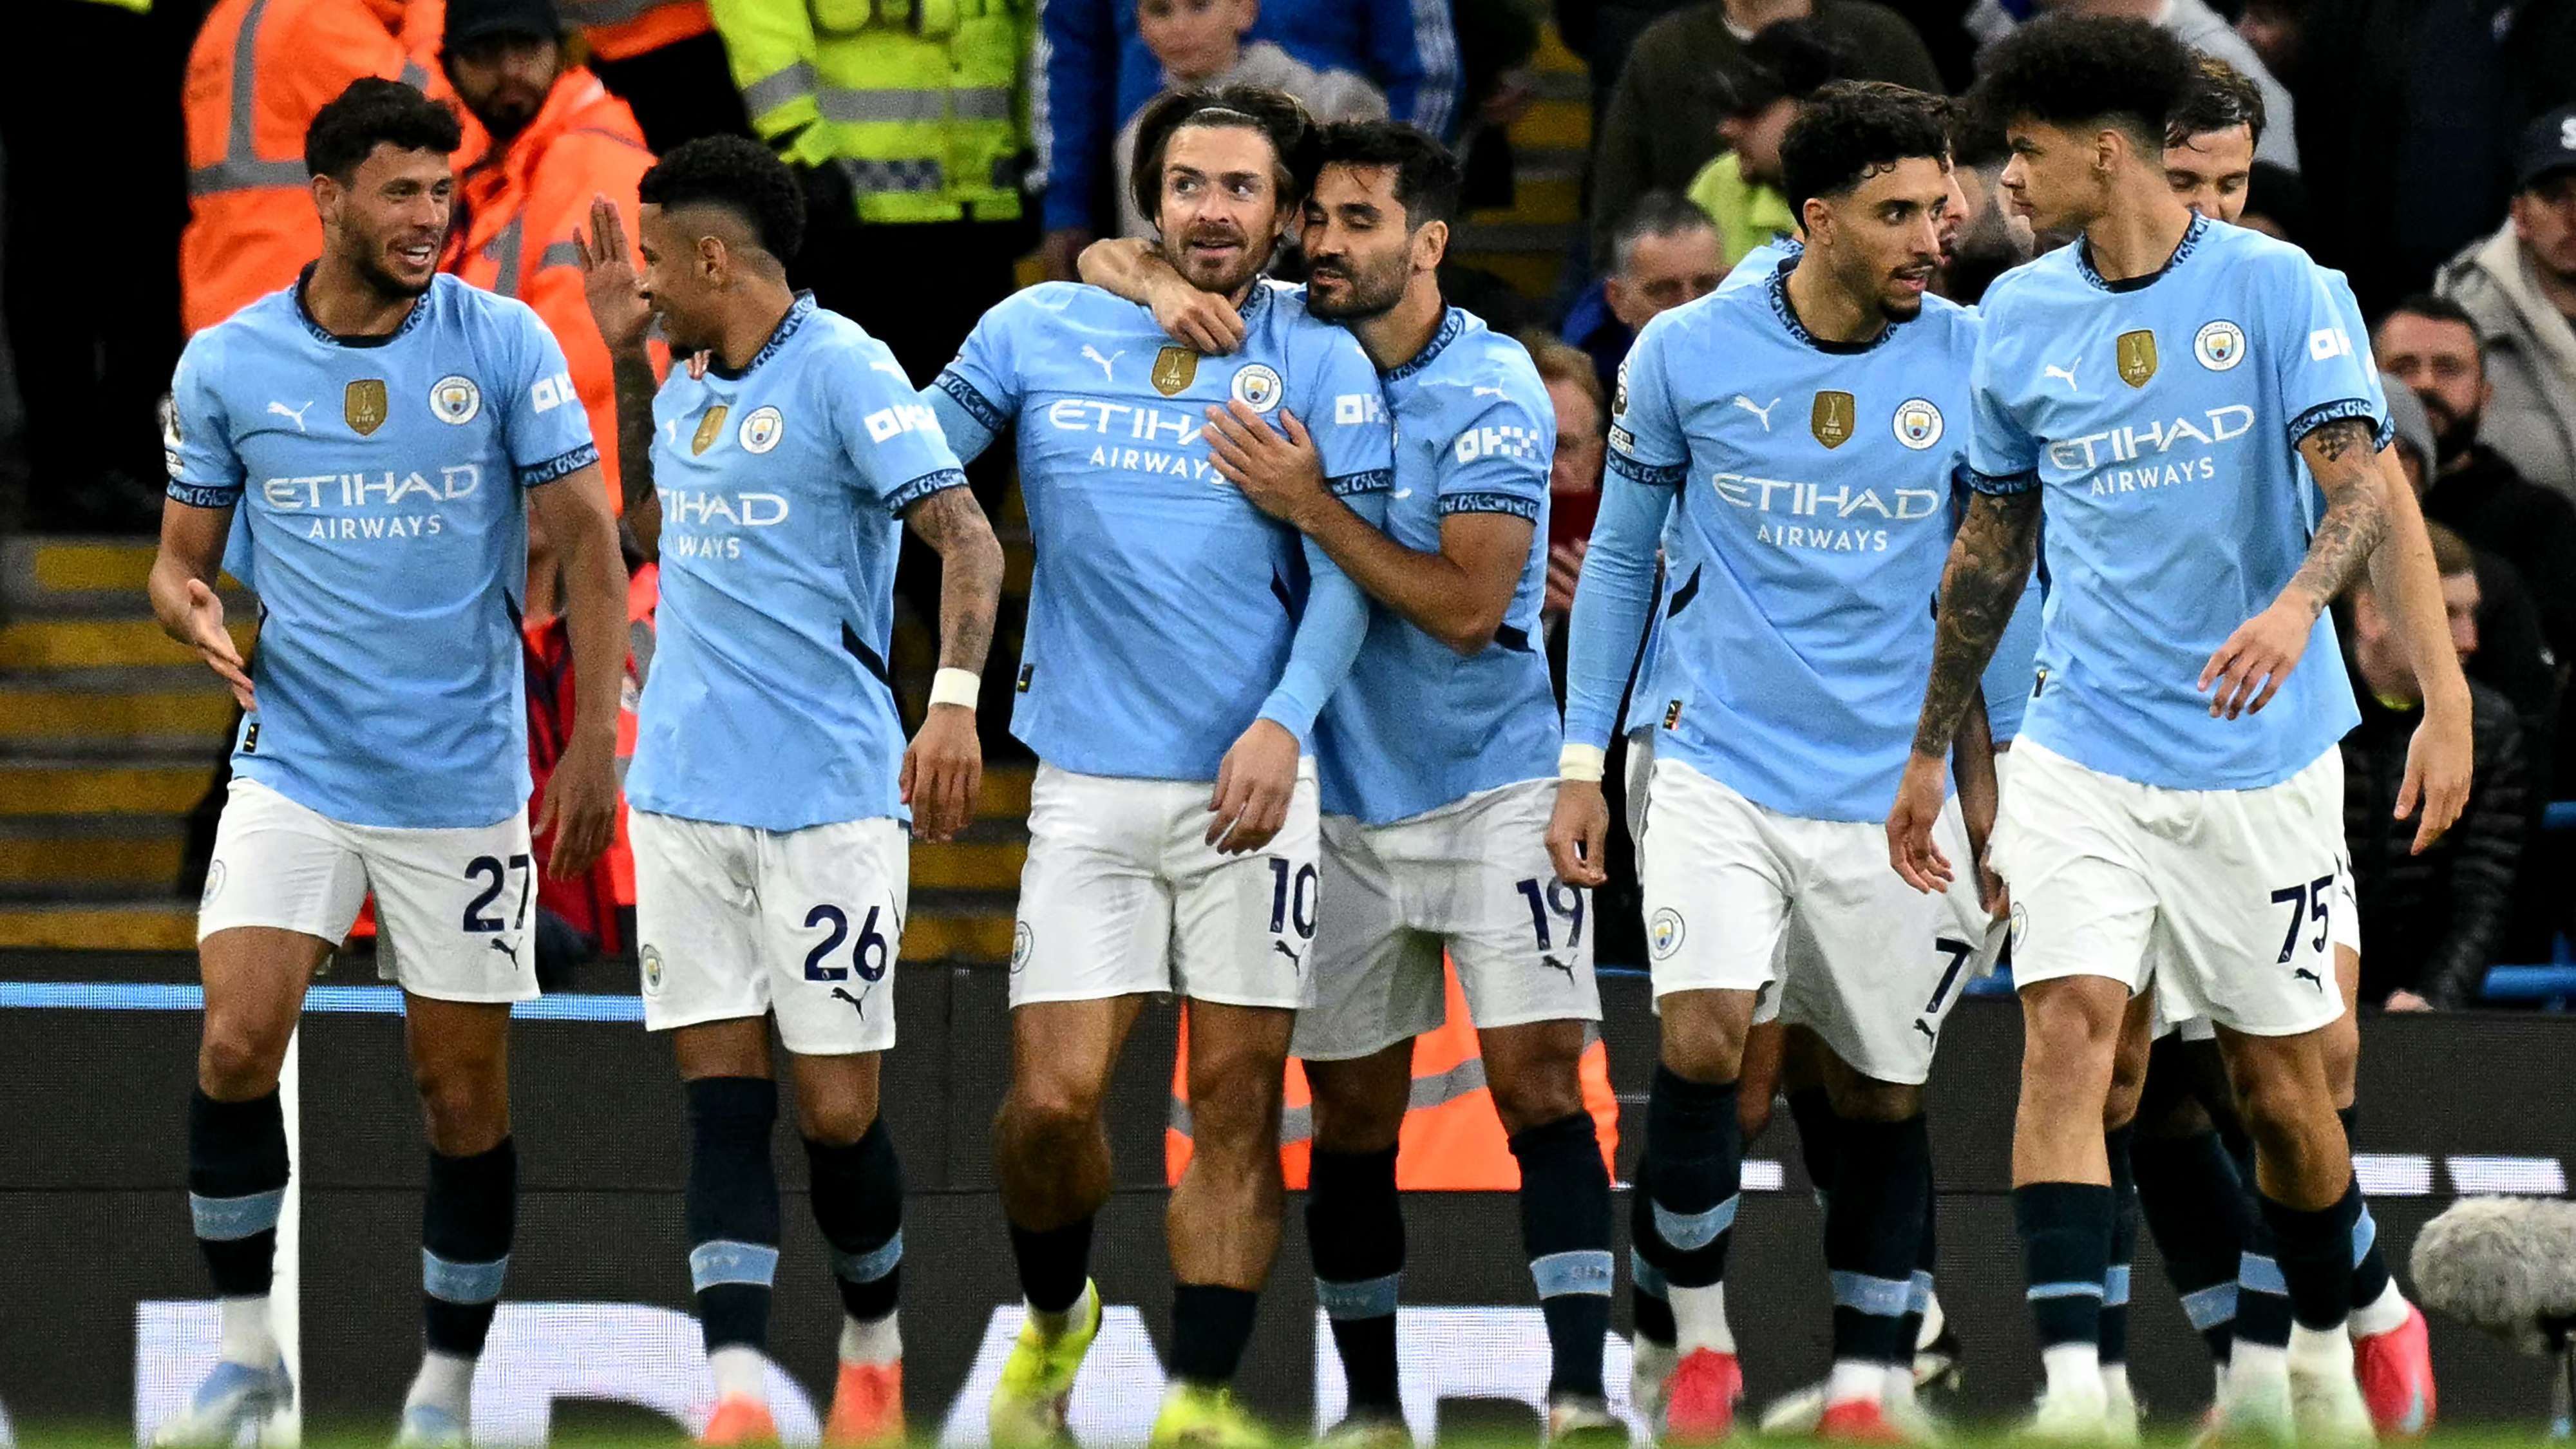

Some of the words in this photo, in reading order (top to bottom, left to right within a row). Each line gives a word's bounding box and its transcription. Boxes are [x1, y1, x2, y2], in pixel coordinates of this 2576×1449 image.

[1161, 377, 1181, 386] FIFA
[2128, 366, 2147, 375] FIFA
[1049, 399, 1222, 446] ETIH
[1822, 426, 1842, 436] FIFA
[2050, 404, 2255, 470] ETIHAD
[264, 464, 480, 509] ETIHAD
[1712, 473, 1940, 520] ETIHAD
[2092, 457, 2215, 496] AIRWAYS
[308, 514, 442, 539] AIRWAYS
[1757, 523, 1888, 552] AIRWAYS
[462, 854, 531, 933] 27
[1268, 857, 1318, 940] 10
[1516, 877, 1585, 951] 19
[2271, 874, 2334, 964] 75
[804, 904, 888, 982] 26
[1925, 936, 1975, 1014] 7
